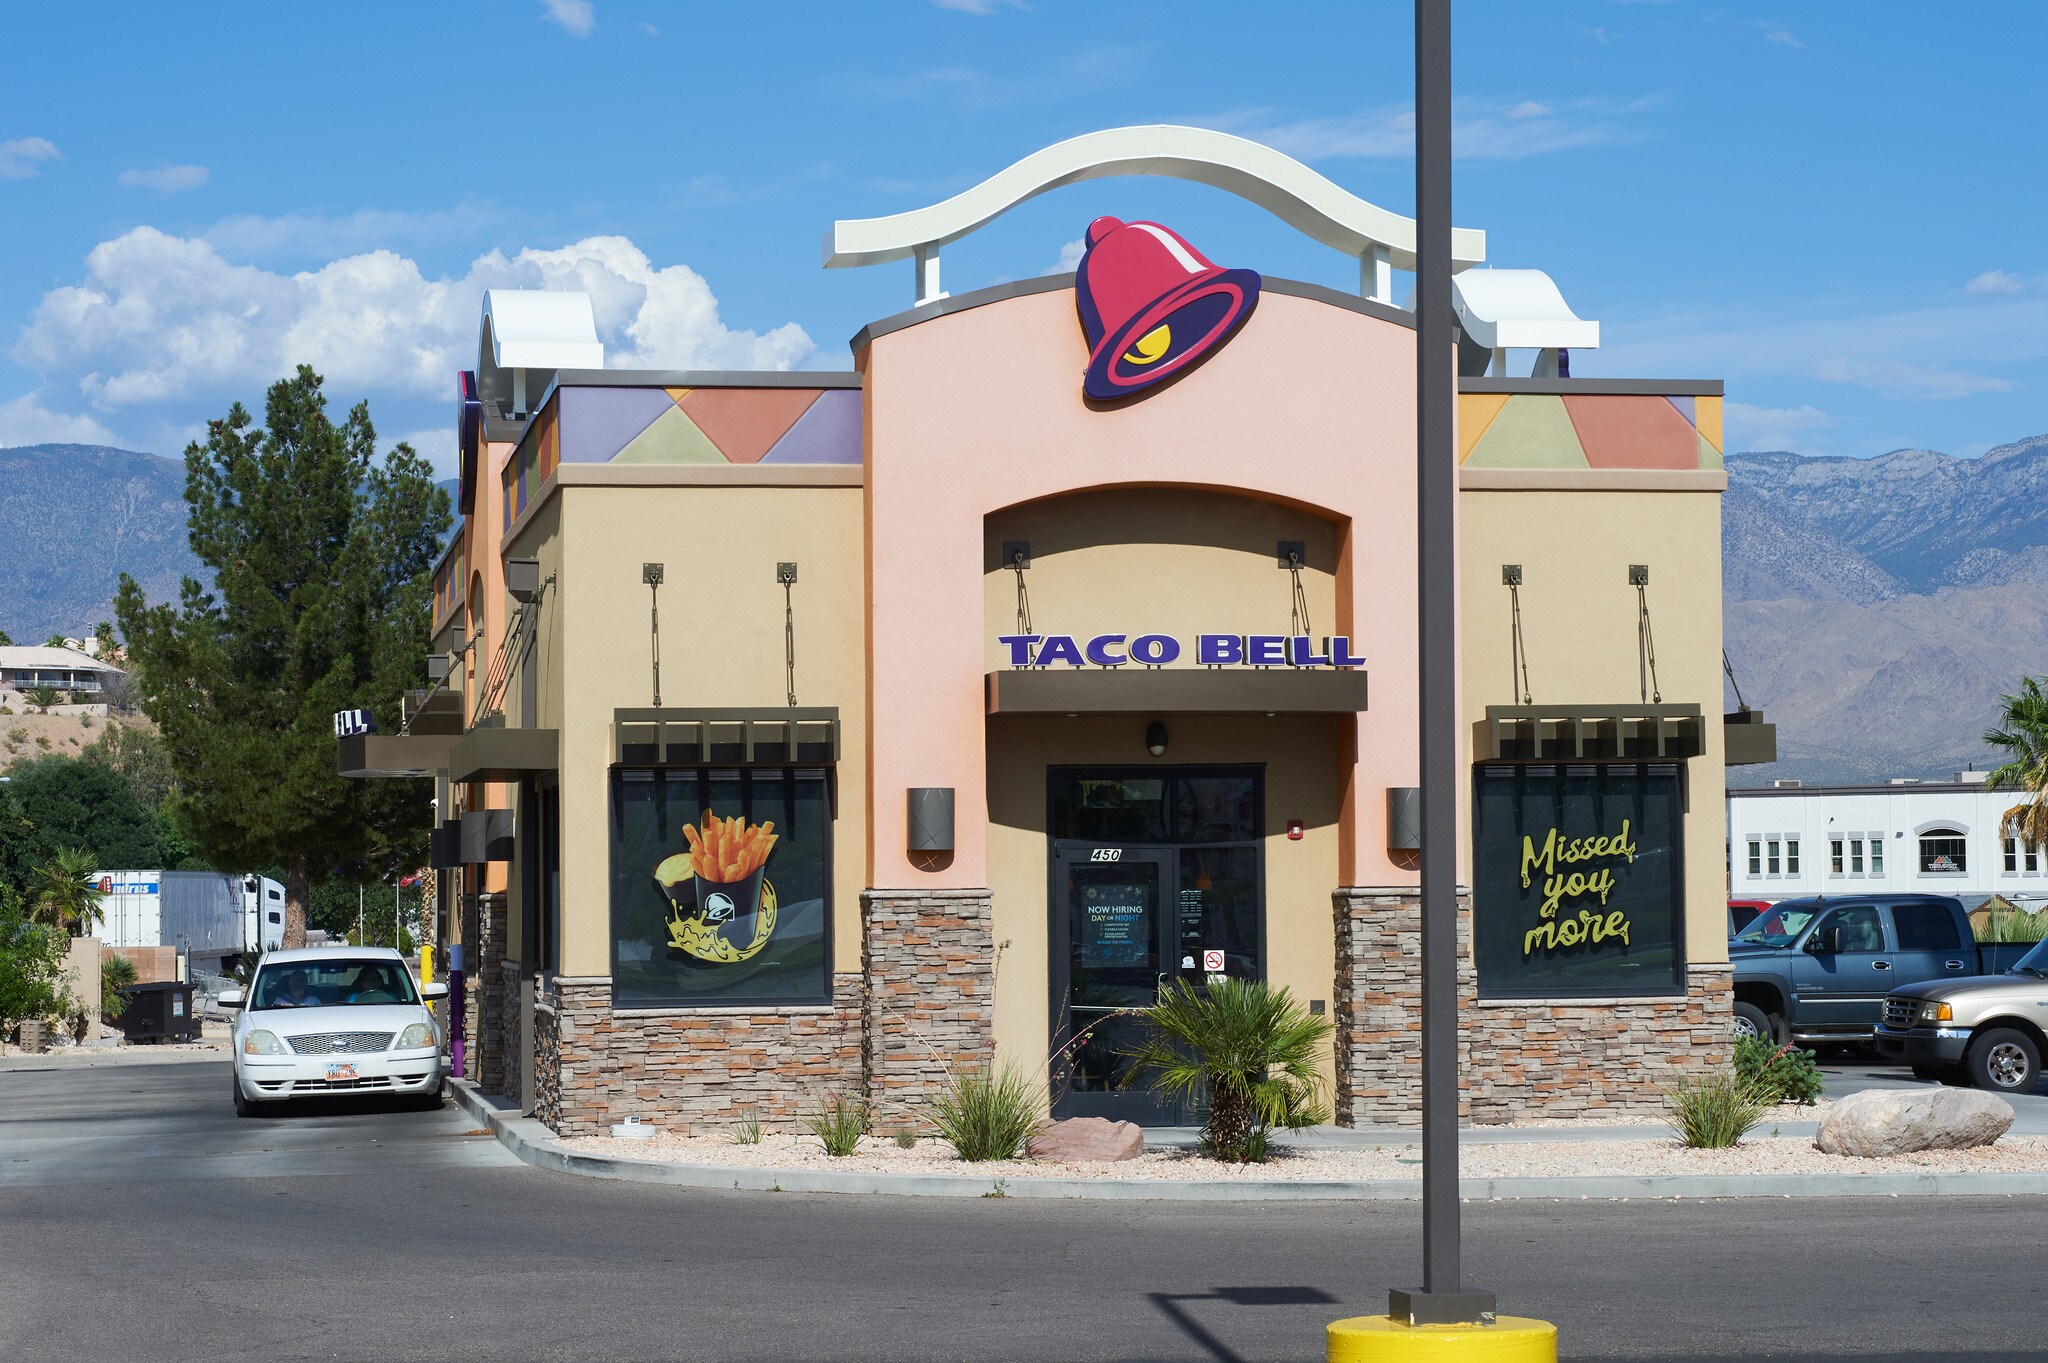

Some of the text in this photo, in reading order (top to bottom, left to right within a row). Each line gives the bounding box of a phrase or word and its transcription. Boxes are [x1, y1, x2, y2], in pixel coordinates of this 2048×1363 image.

[997, 634, 1367, 667] TACO BELL
[1092, 849, 1120, 861] 450
[1520, 818, 1637, 889] Missed
[1088, 905, 1143, 914] NOW HIRING
[1539, 868, 1616, 918] you
[1091, 914, 1106, 922] DAY
[1114, 914, 1140, 922] NIGHT
[1523, 909, 1631, 955] more
